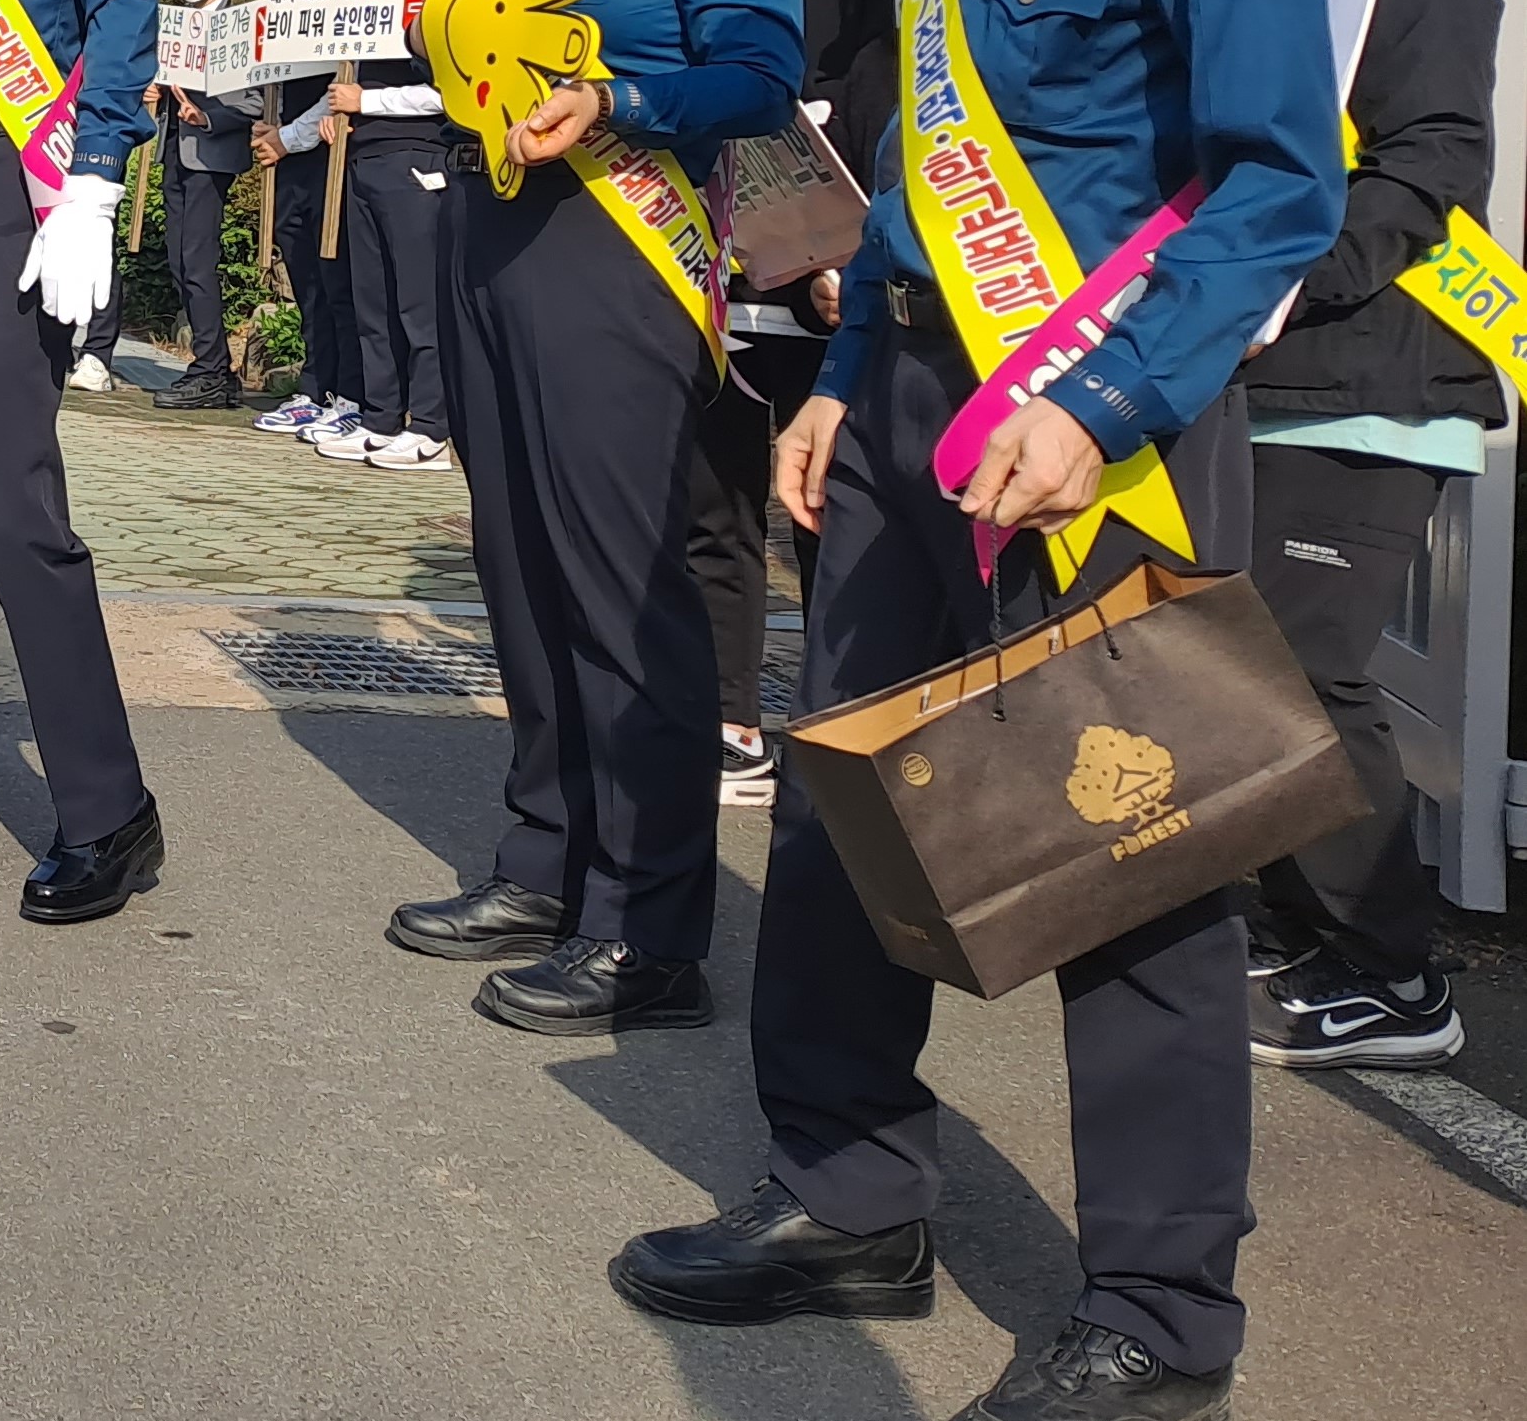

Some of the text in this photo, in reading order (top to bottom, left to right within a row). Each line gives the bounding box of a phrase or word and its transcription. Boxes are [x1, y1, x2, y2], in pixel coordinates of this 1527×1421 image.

[210, 6, 251, 41] 맑은 가슴
[267, 5, 395, 40] 남이 피워 살인행위
[158, 41, 207, 73] 다운 미래
[209, 40, 250, 74] 푸른 건강
[1422, 239, 1521, 331] 신의
[1110, 808, 1192, 862] FOREST
